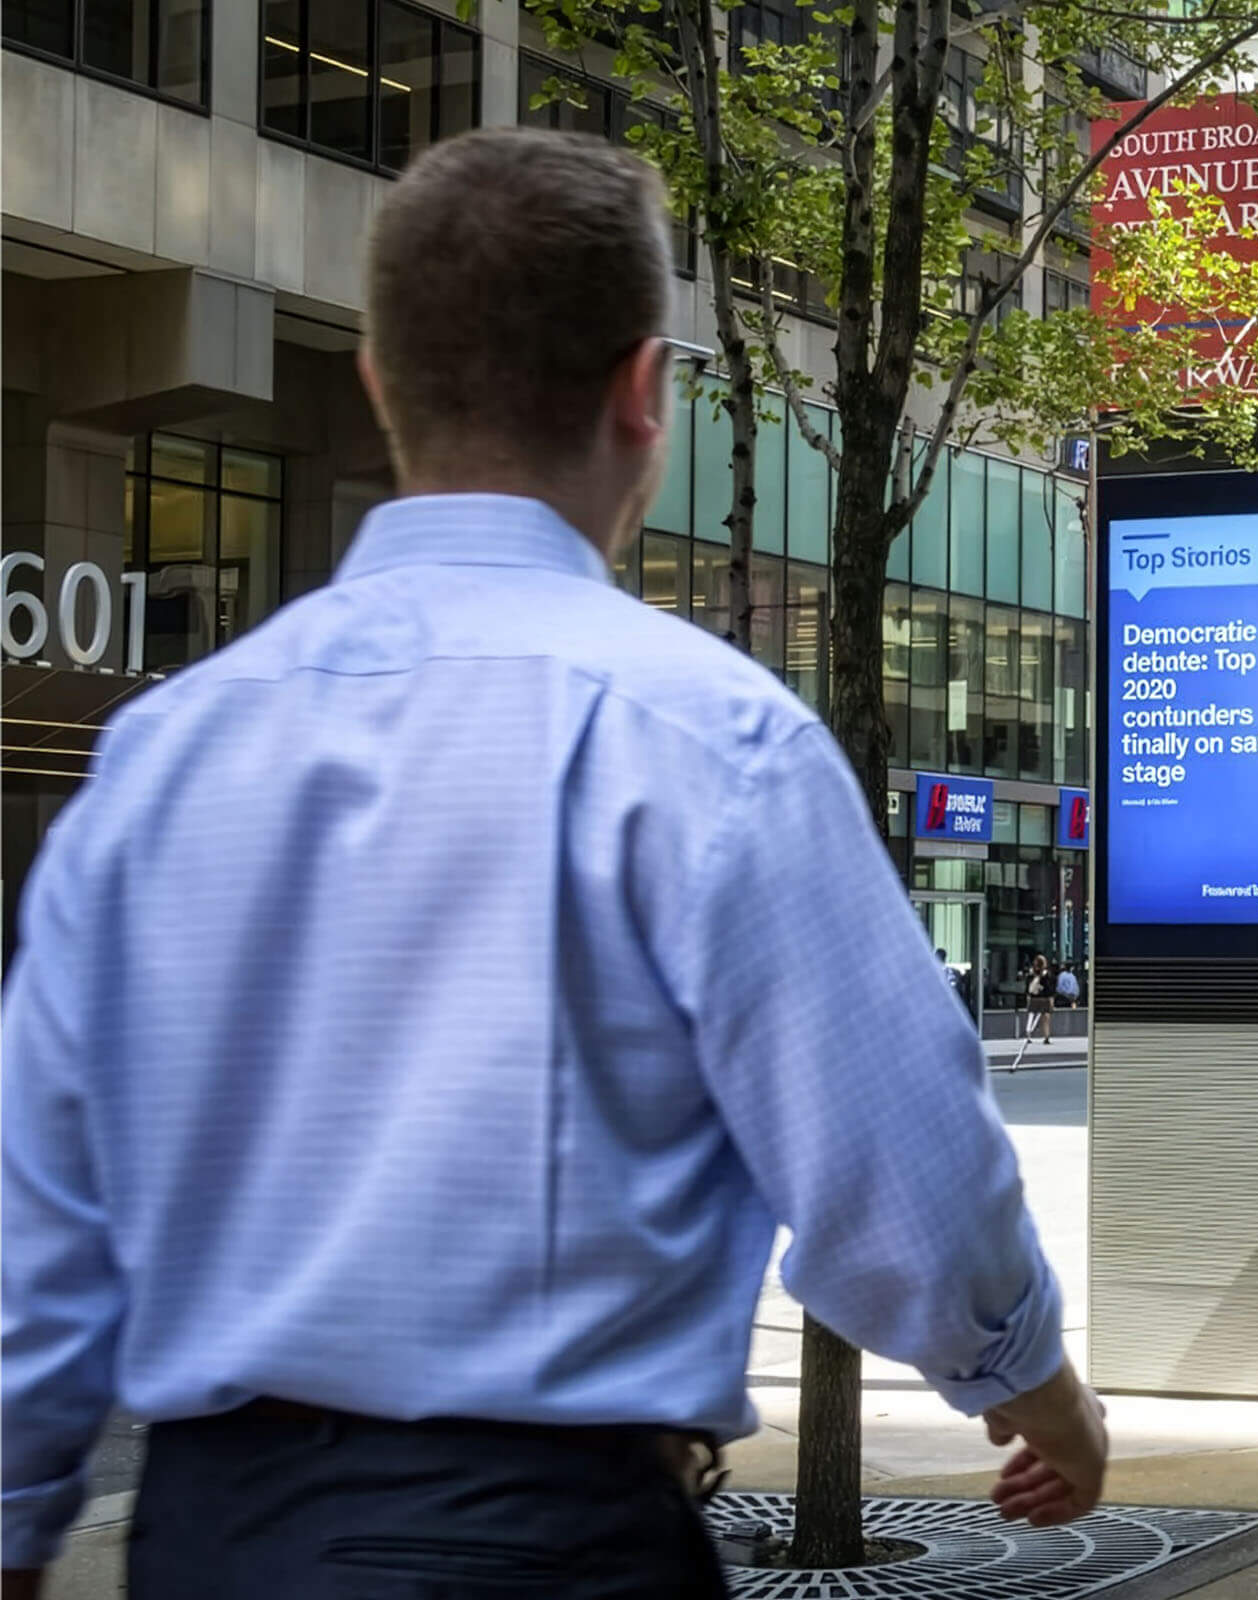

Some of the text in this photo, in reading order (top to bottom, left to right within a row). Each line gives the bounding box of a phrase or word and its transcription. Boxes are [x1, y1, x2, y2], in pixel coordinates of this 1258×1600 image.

[1109, 128, 1198, 158] SOUTH
[1122, 548, 1165, 574] Top
[0, 552, 147, 672] 601
[1214, 648, 1257, 675] Top
[1122, 678, 1177, 700] 2020
[1194, 737, 1224, 753] on
[1121, 762, 1186, 787] stage
